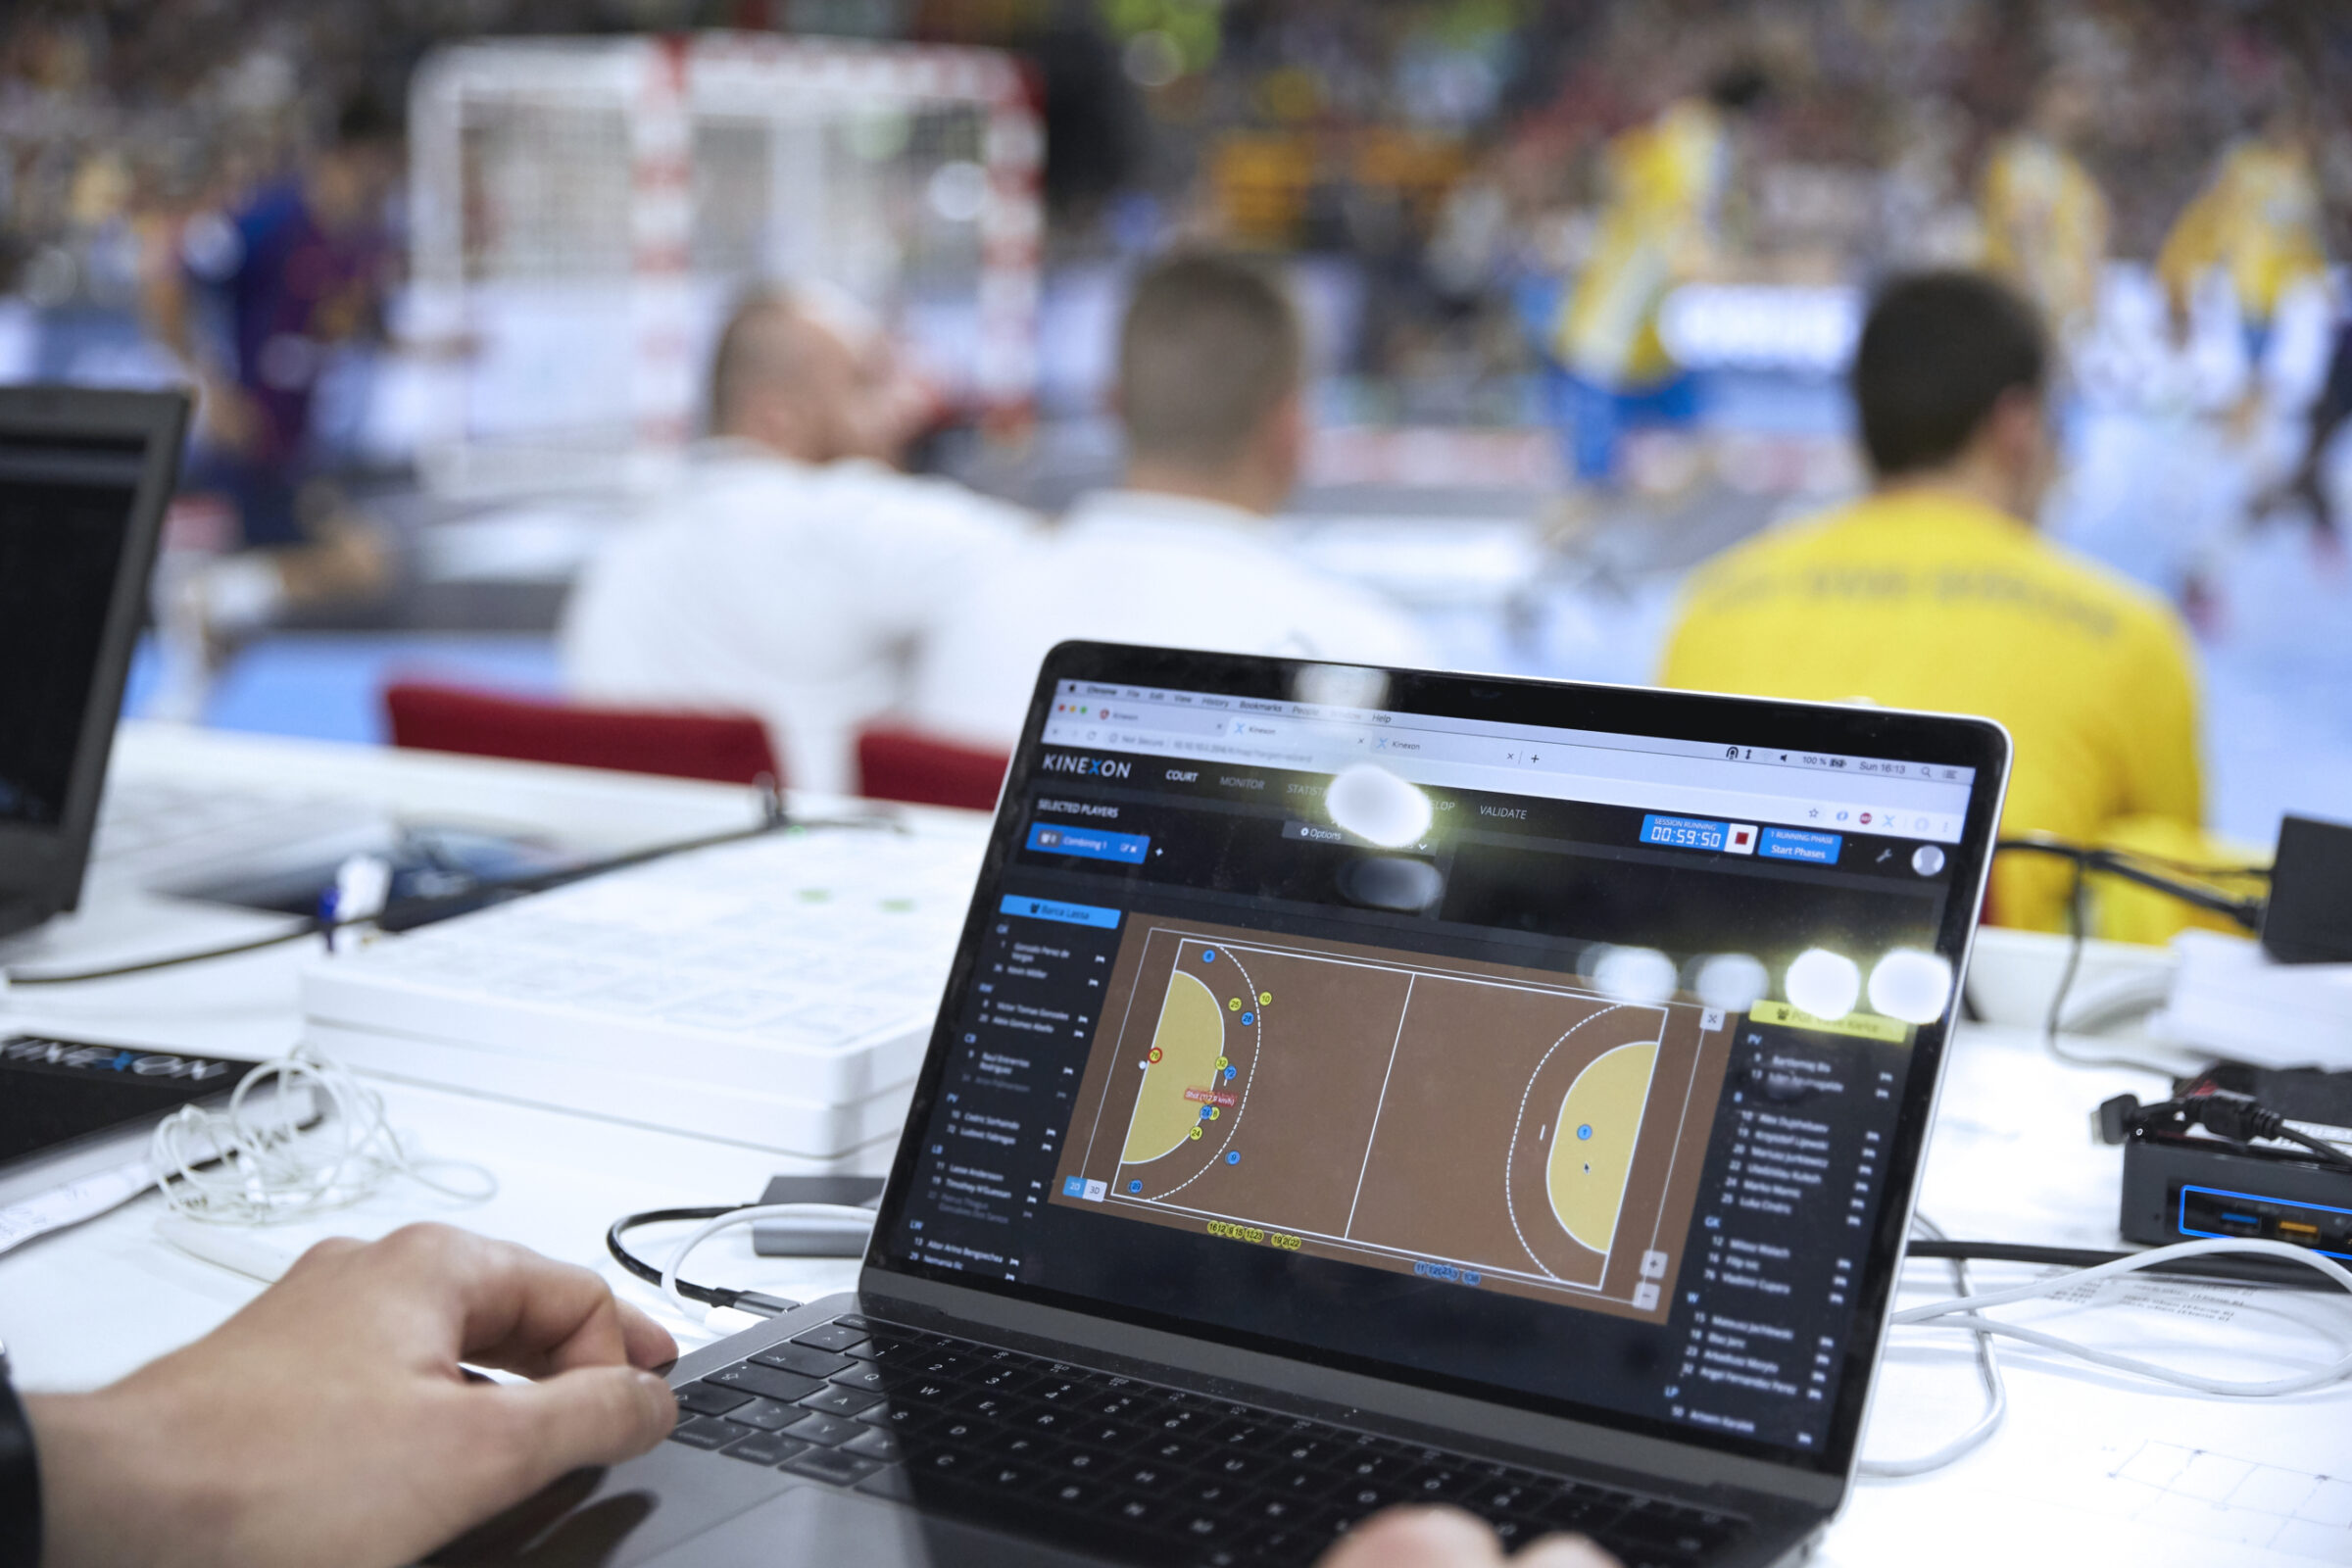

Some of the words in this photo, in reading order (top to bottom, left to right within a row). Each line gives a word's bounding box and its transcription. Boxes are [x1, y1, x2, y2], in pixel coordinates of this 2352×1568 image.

[1201, 698, 1229, 709] History
[1240, 701, 1283, 712] Bookmarks
[1293, 706, 1319, 716] People
[1372, 713, 1392, 724] Help
[1392, 740, 1421, 751] Kinexon
[1042, 753, 1132, 778] KINEXON
[1802, 756, 1817, 764] 100
[1859, 761, 1879, 772] Sun
[1881, 763, 1906, 774] 16:13
[1165, 769, 1199, 783] COURT
[1219, 775, 1265, 790] MONITOR
[1036, 799, 1080, 814] SELECTED
[1081, 805, 1119, 819] PLAYERS
[1480, 806, 1528, 820] VALIDATE
[1654, 817, 1683, 828] SESSION
[1684, 821, 1716, 831] RUNNING
[1309, 828, 1342, 841] Options
[1651, 826, 1722, 848] 00:59:50
[1777, 832, 1809, 842] RUNNING
[1810, 835, 1834, 845] PHASE
[1771, 844, 1793, 856] Start
[1794, 847, 1826, 859] Phases
[1747, 1034, 1762, 1045] PV
[1069, 1182, 1081, 1192] 2D
[1090, 1185, 1101, 1195] 3D
[1705, 1216, 1721, 1228] GK
[1713, 1236, 1724, 1247] 12
[1687, 1292, 1699, 1303] W
[1694, 1312, 1705, 1323] 15
[920, 1386, 941, 1396] W
[1045, 1391, 1059, 1399] 4
[1664, 1386, 1680, 1398] LP
[834, 1396, 849, 1405] A
[979, 1400, 996, 1409] E
[892, 1411, 907, 1420] S
[1038, 1415, 1054, 1424] R
[950, 1426, 967, 1436] D
[1102, 1430, 1117, 1439] T
[937, 1455, 956, 1466] C
